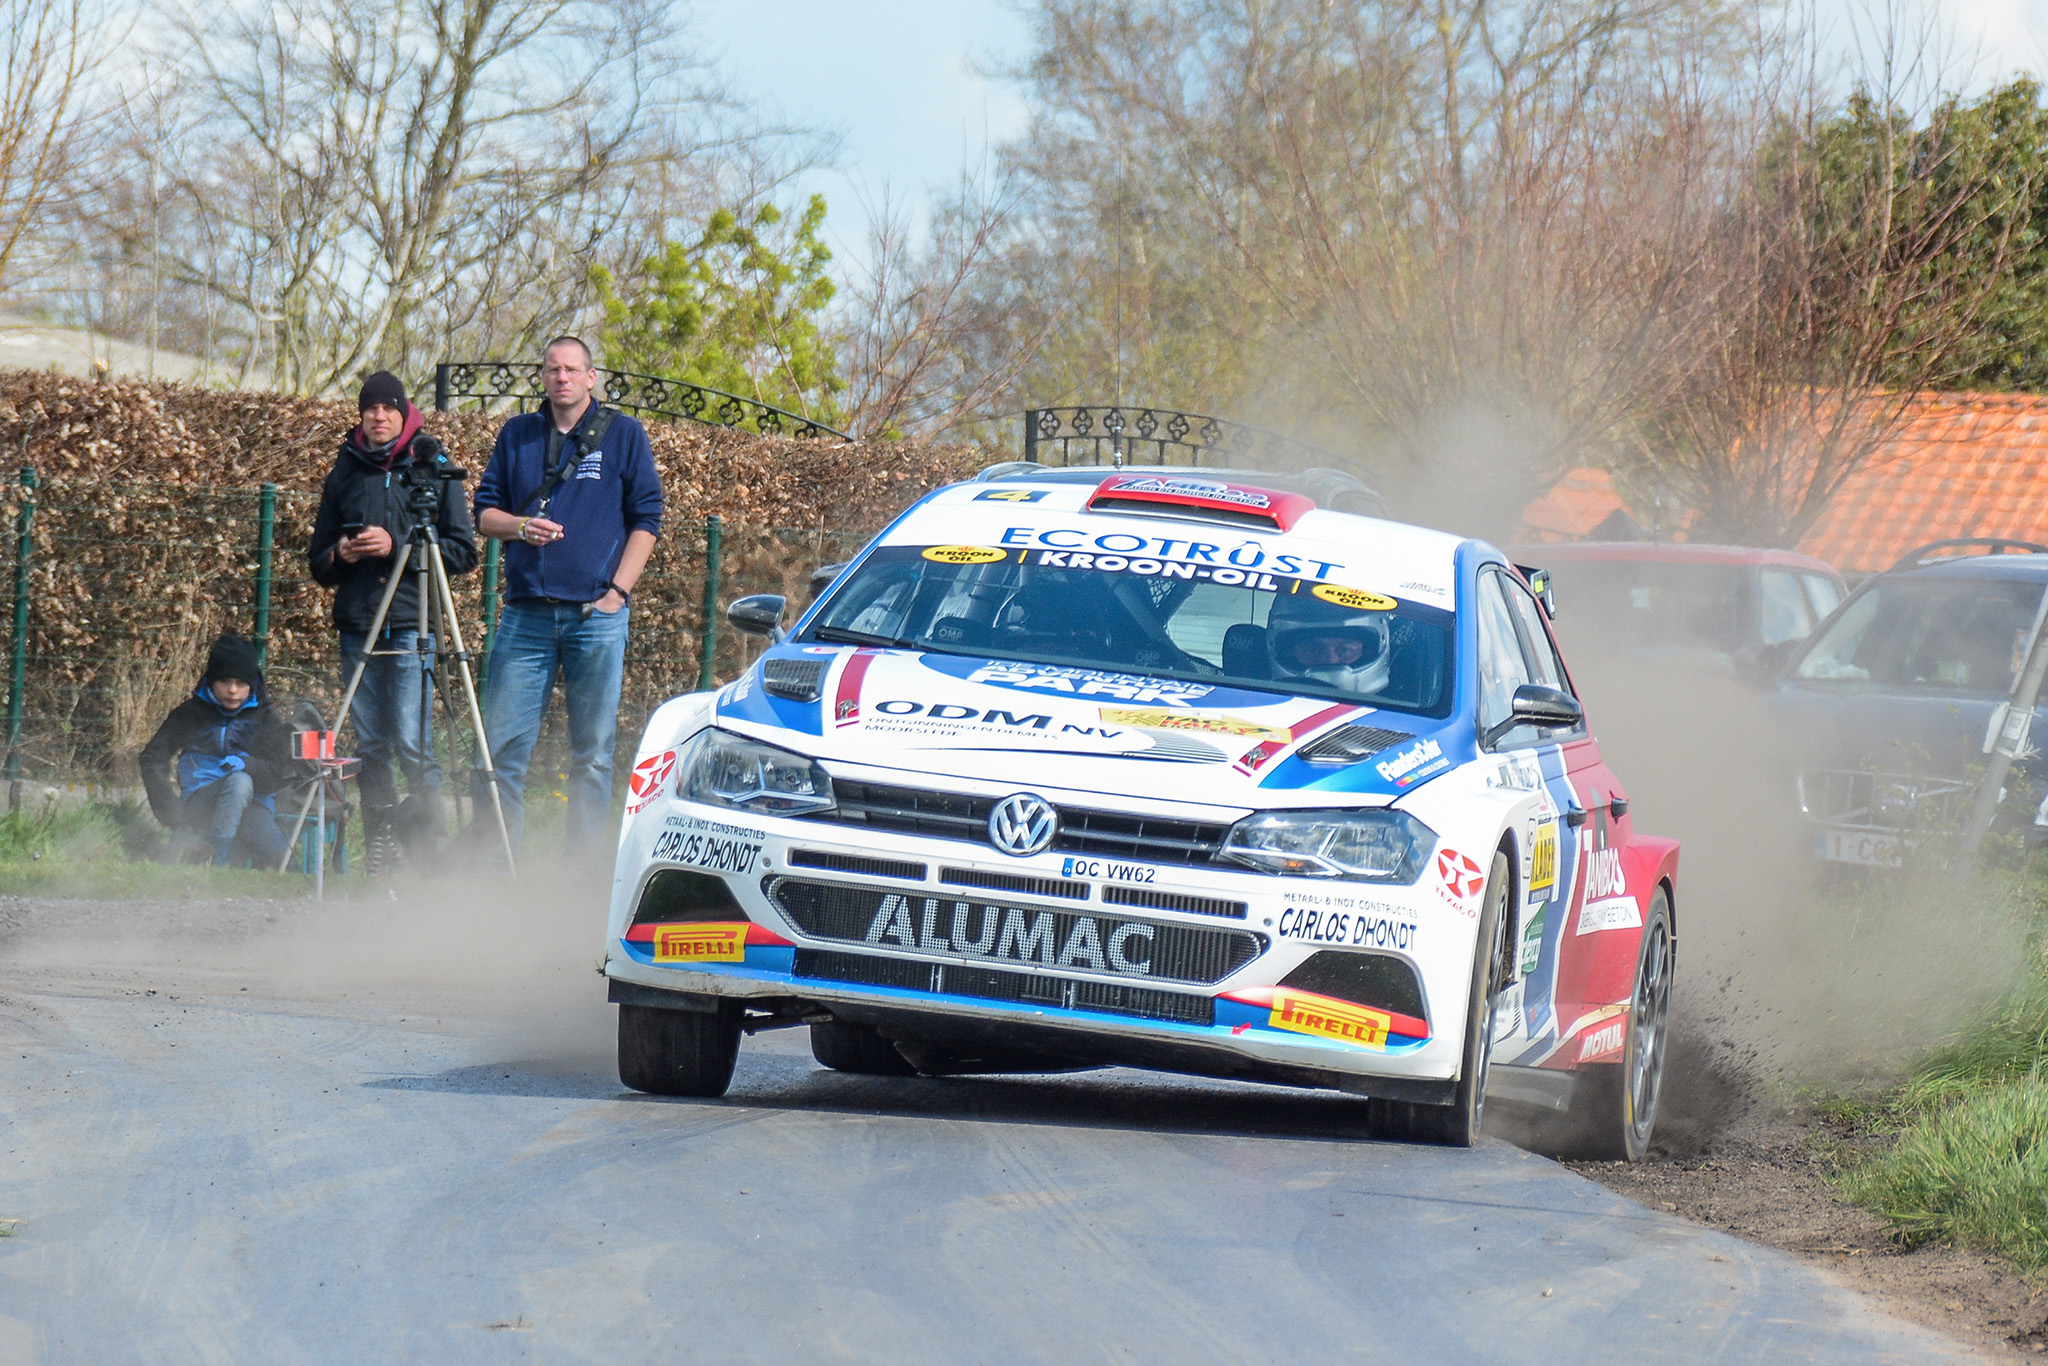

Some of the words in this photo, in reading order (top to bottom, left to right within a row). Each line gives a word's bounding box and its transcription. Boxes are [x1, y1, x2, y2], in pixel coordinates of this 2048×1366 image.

[988, 489, 1032, 502] 4
[1038, 550, 1279, 591] KROON-OIL
[1325, 589, 1385, 605] KROON
[1339, 597, 1364, 607] OIL
[967, 669, 1203, 707] PARK
[865, 725, 961, 737] MOORSLEDE
[868, 717, 993, 732] ONTGINNINGEN
[875, 700, 1054, 729] ODM
[1061, 723, 1125, 739] NV
[626, 788, 664, 815] TEXACO
[693, 820, 710, 831] INOX
[711, 822, 766, 840] CONSTRUCTIES
[652, 830, 703, 863] CARLOS
[699, 837, 763, 874] DHONDT
[1075, 860, 1100, 877] OC
[1107, 863, 1155, 883] VW62
[1334, 897, 1355, 908] INOX
[1359, 900, 1418, 919] CONSTRUCTIES
[1435, 885, 1476, 918] TEXACO
[866, 894, 1155, 975] ALUMAC
[1279, 907, 1350, 942] CARLOS
[1352, 915, 1417, 951] DHONDT
[661, 930, 738, 957] PIRELLI
[1280, 998, 1380, 1043] PIRELLI
[1580, 1022, 1623, 1061] MOTUL
